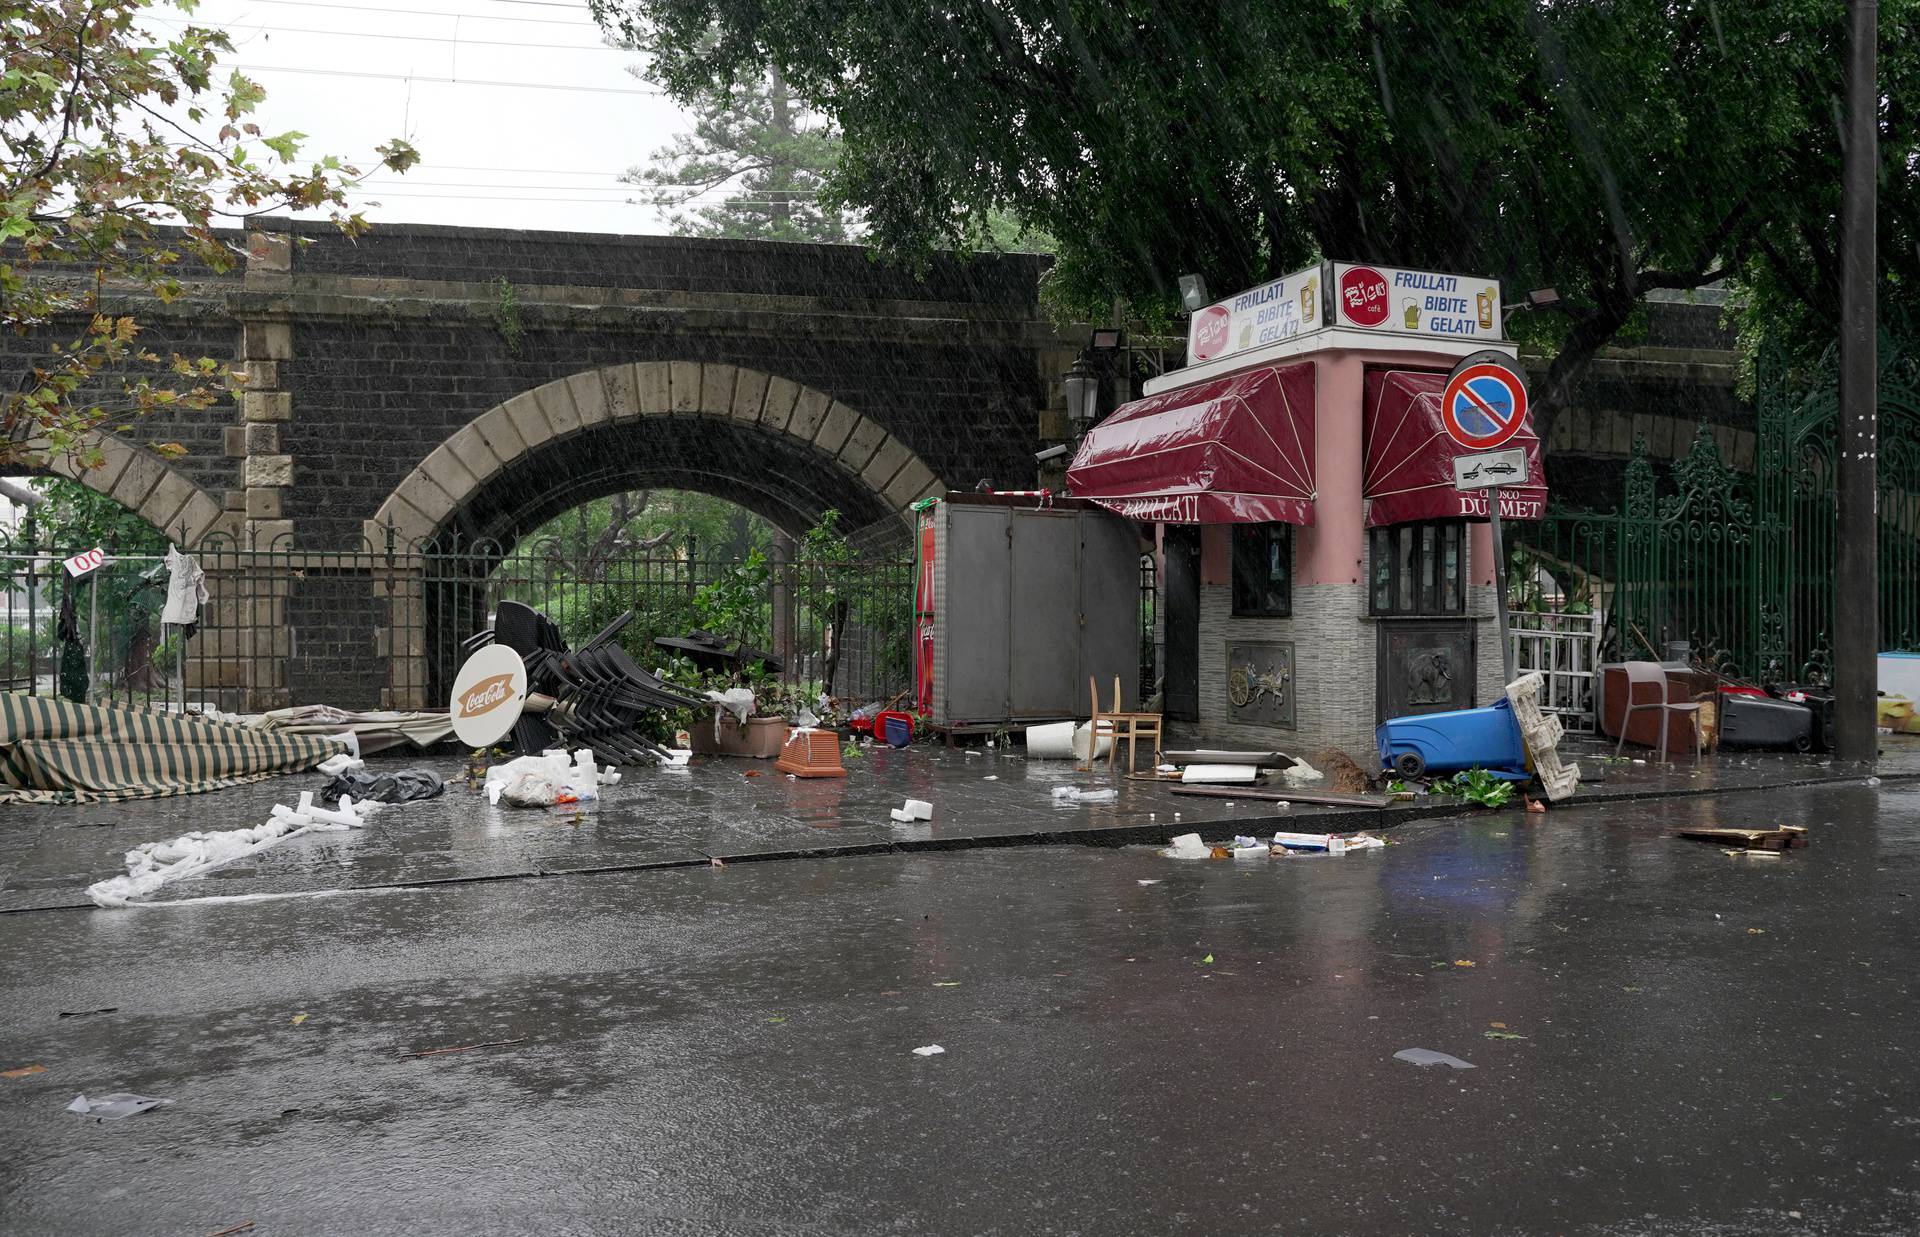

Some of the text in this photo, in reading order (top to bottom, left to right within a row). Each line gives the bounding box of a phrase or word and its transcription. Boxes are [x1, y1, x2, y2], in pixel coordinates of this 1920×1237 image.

[1394, 271, 1457, 293] FRULLATI
[1234, 282, 1284, 313] FRULLATI
[1424, 295, 1469, 314] BIBITE
[1256, 300, 1294, 325] BIBITE
[1259, 319, 1299, 344] GELATI
[1430, 316, 1476, 335] GELATI
[1458, 497, 1541, 518] DUMET
